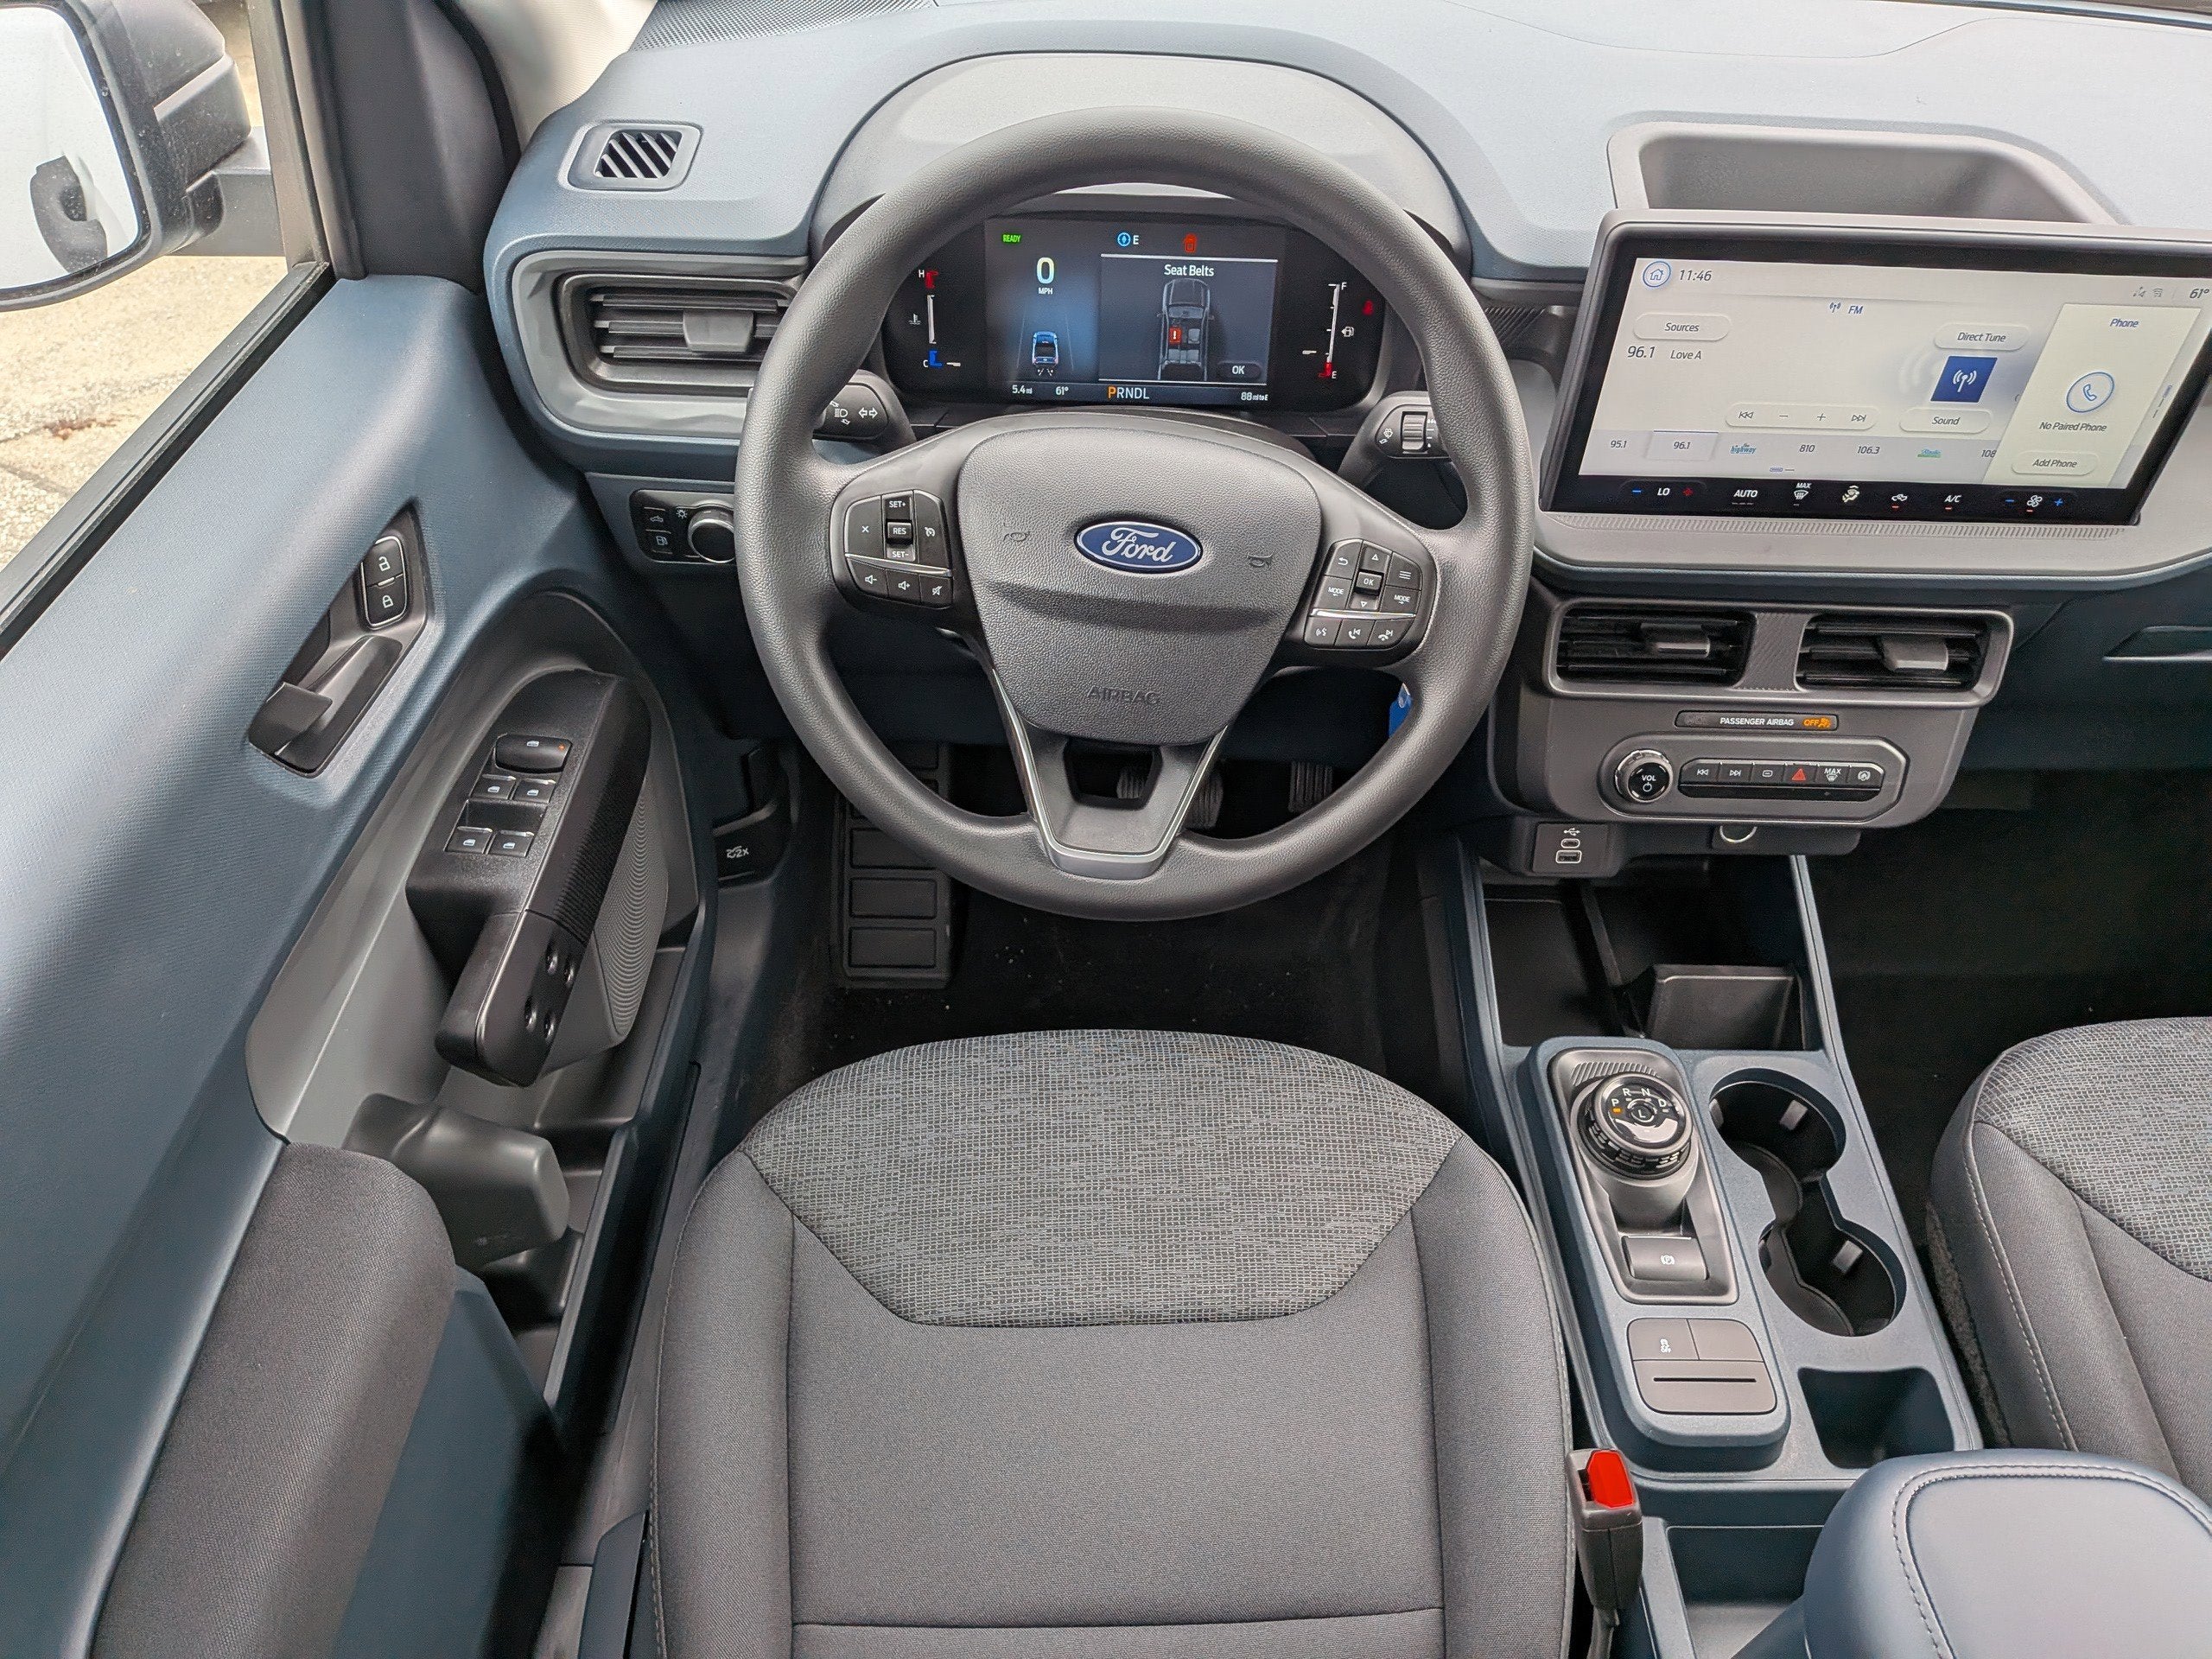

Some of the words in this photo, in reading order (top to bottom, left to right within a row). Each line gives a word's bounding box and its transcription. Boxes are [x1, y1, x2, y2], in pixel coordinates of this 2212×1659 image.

[1002, 234, 1021, 243] READY
[1133, 235, 1140, 245] E
[918, 269, 925, 278] H
[1037, 257, 1055, 284] 0
[1164, 264, 1188, 276] Seat
[1189, 264, 1215, 276] Belts
[1679, 270, 1713, 282] 11:46
[1341, 282, 1347, 290] F
[1847, 305, 1864, 315] FM
[1664, 322, 1700, 333] Sources
[2109, 318, 2139, 328] Phone
[1956, 332, 1983, 342] Direct
[1985, 333, 2006, 343] Tune
[1627, 346, 1656, 359] 96.1
[1669, 350, 1694, 360] Love
[1694, 350, 1702, 360] A
[1231, 365, 1245, 375] OK
[1332, 371, 1338, 379] E
[1932, 416, 1961, 426] Sound
[2038, 421, 2052, 430] No
[2053, 422, 2079, 431] Paired
[2079, 423, 2107, 432] Phone
[1610, 440, 1627, 448] 95.1
[1673, 441, 1691, 450] 96.1
[1799, 444, 1815, 453] 810
[1857, 446, 1880, 454] 106.3
[2032, 459, 2050, 467] Add
[2051, 460, 2077, 469] Phone
[1656, 487, 1670, 496] LO
[1733, 489, 1759, 499] AUTO
[1944, 494, 1962, 503] A/C
[1102, 526, 1177, 563] Ford
[1363, 577, 1375, 587] OK
[1327, 586, 1344, 595] MODE
[1394, 594, 1411, 603] MODE
[1719, 717, 1765, 727] PASSENGER
[1766, 718, 1795, 727] AIRBAG
[1802, 719, 1819, 728] OFF
[1622, 1088, 1632, 1096] R
[1641, 1088, 1651, 1096] N
[1611, 1098, 1620, 1107] P
[1657, 1098, 1668, 1108] D
[1637, 1109, 1646, 1119] L
